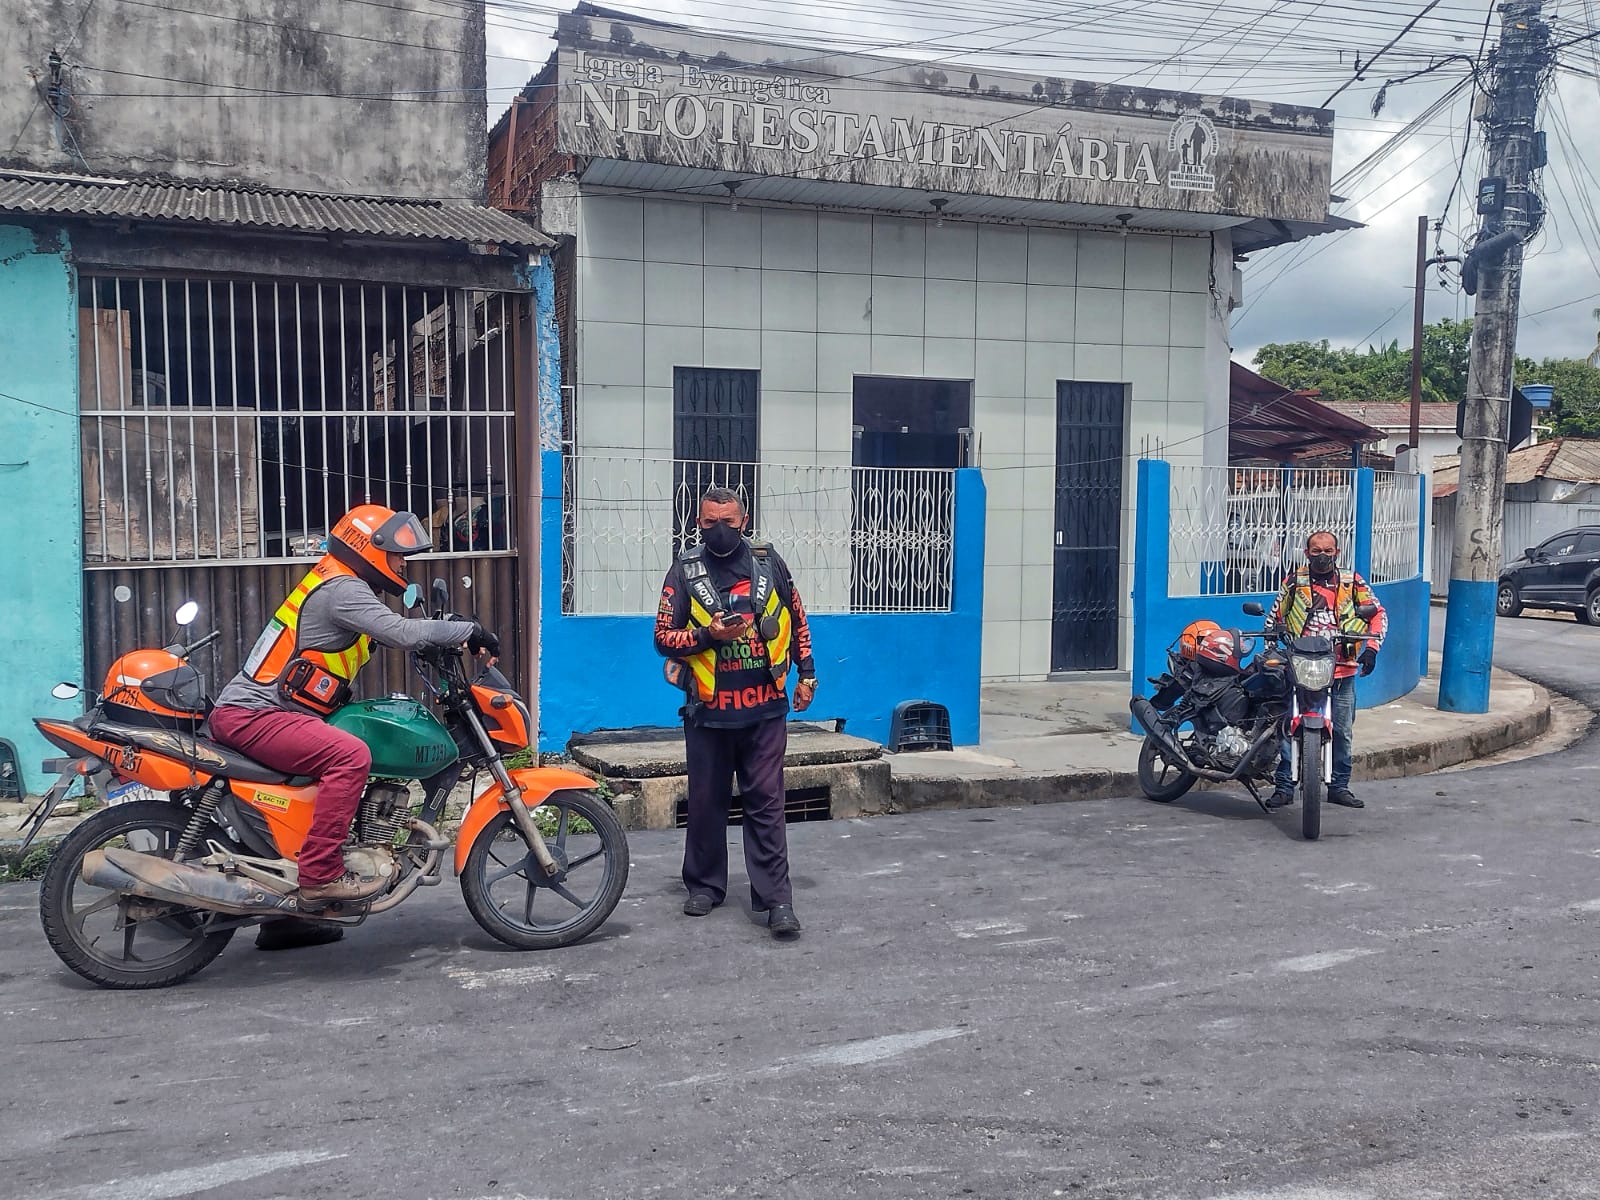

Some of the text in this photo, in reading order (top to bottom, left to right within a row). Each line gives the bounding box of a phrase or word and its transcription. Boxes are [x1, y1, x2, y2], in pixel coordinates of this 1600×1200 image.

[573, 50, 831, 104] Igreja Evangélica
[574, 80, 1161, 186] NEOTESTAMENTÁRIA
[694, 581, 714, 606] MOTO
[756, 575, 768, 601] TAXI
[718, 639, 766, 660] otota
[415, 745, 431, 764] MT
